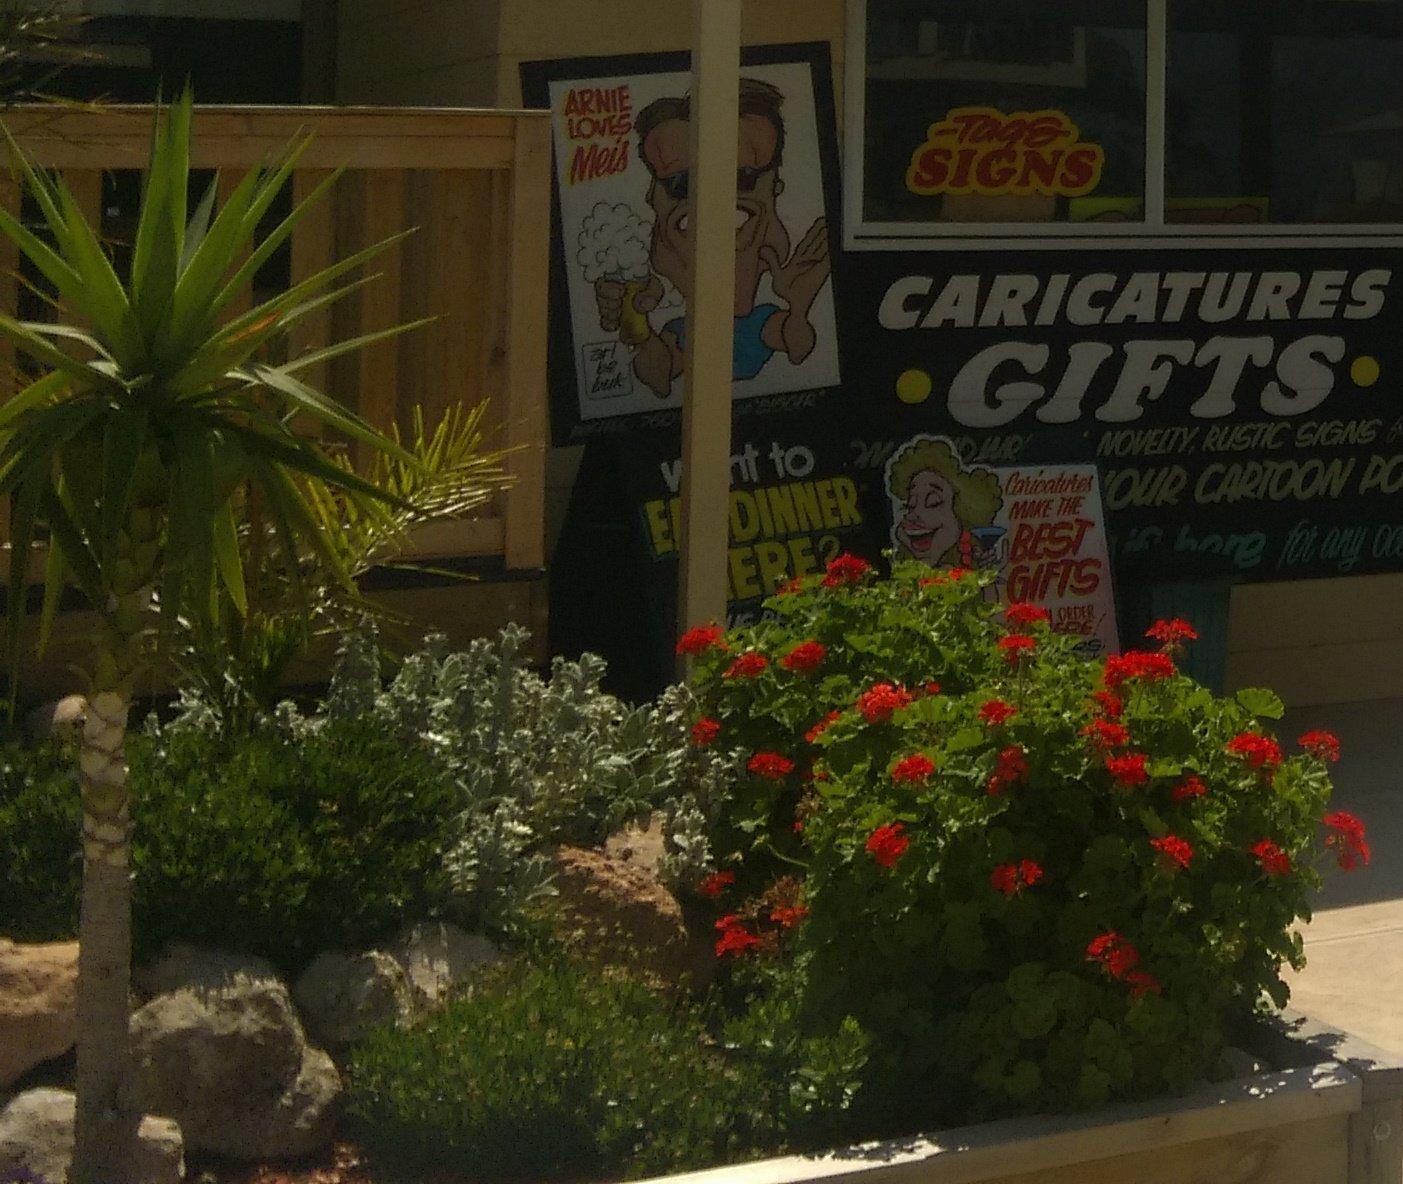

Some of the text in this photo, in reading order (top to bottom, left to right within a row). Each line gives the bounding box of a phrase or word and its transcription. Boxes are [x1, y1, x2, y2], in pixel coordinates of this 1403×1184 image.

[564, 85, 632, 116] ARNIE
[567, 113, 632, 140] LOVES
[913, 145, 1097, 190] SIGNS
[878, 270, 1393, 330] CARICATURES
[946, 335, 1346, 428] GIFTS
[1202, 421, 1290, 453] RUSTIC
[1294, 418, 1380, 448] SIGNS
[769, 441, 815, 479] to
[1003, 469, 1094, 496] Caricatures
[1194, 457, 1357, 504] CARTOON
[728, 475, 864, 544] DINNER
[1009, 496, 1085, 520] MAKE THE
[1008, 518, 1095, 563] BEST
[728, 535, 840, 599] ERE?
[1006, 559, 1101, 604] GIFTS
